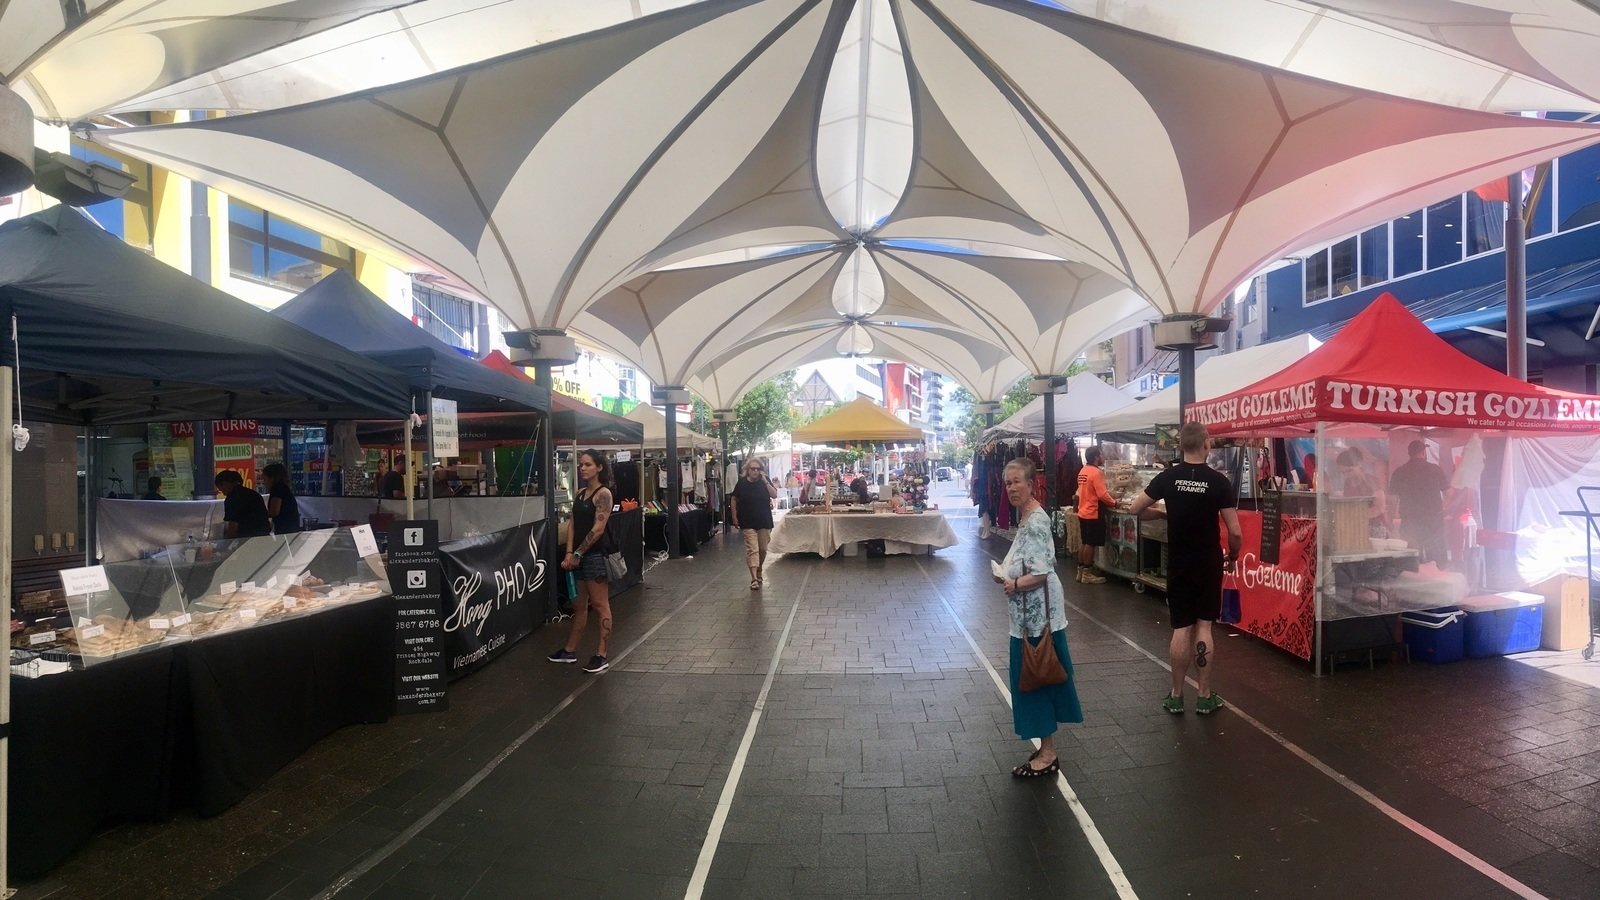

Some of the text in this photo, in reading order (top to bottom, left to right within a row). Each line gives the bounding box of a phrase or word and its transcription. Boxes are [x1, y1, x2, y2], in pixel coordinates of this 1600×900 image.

[565, 380, 580, 395] OFF
[1184, 380, 1317, 425] TURKISH GOZLEME
[1326, 381, 1477, 416] TURKISH
[172, 419, 256, 434] TAX TURNS
[1467, 418, 1478, 426] We
[1479, 418, 1495, 426] cater
[1496, 419, 1506, 427] for
[214, 444, 252, 458] VITAMINS
[1174, 479, 1209, 488] PERSONAL
[1177, 485, 1206, 493] TRAINER
[494, 561, 526, 611] PHO
[418, 620, 440, 629] 6796
[453, 633, 506, 669] Vietnamese Cuisine
